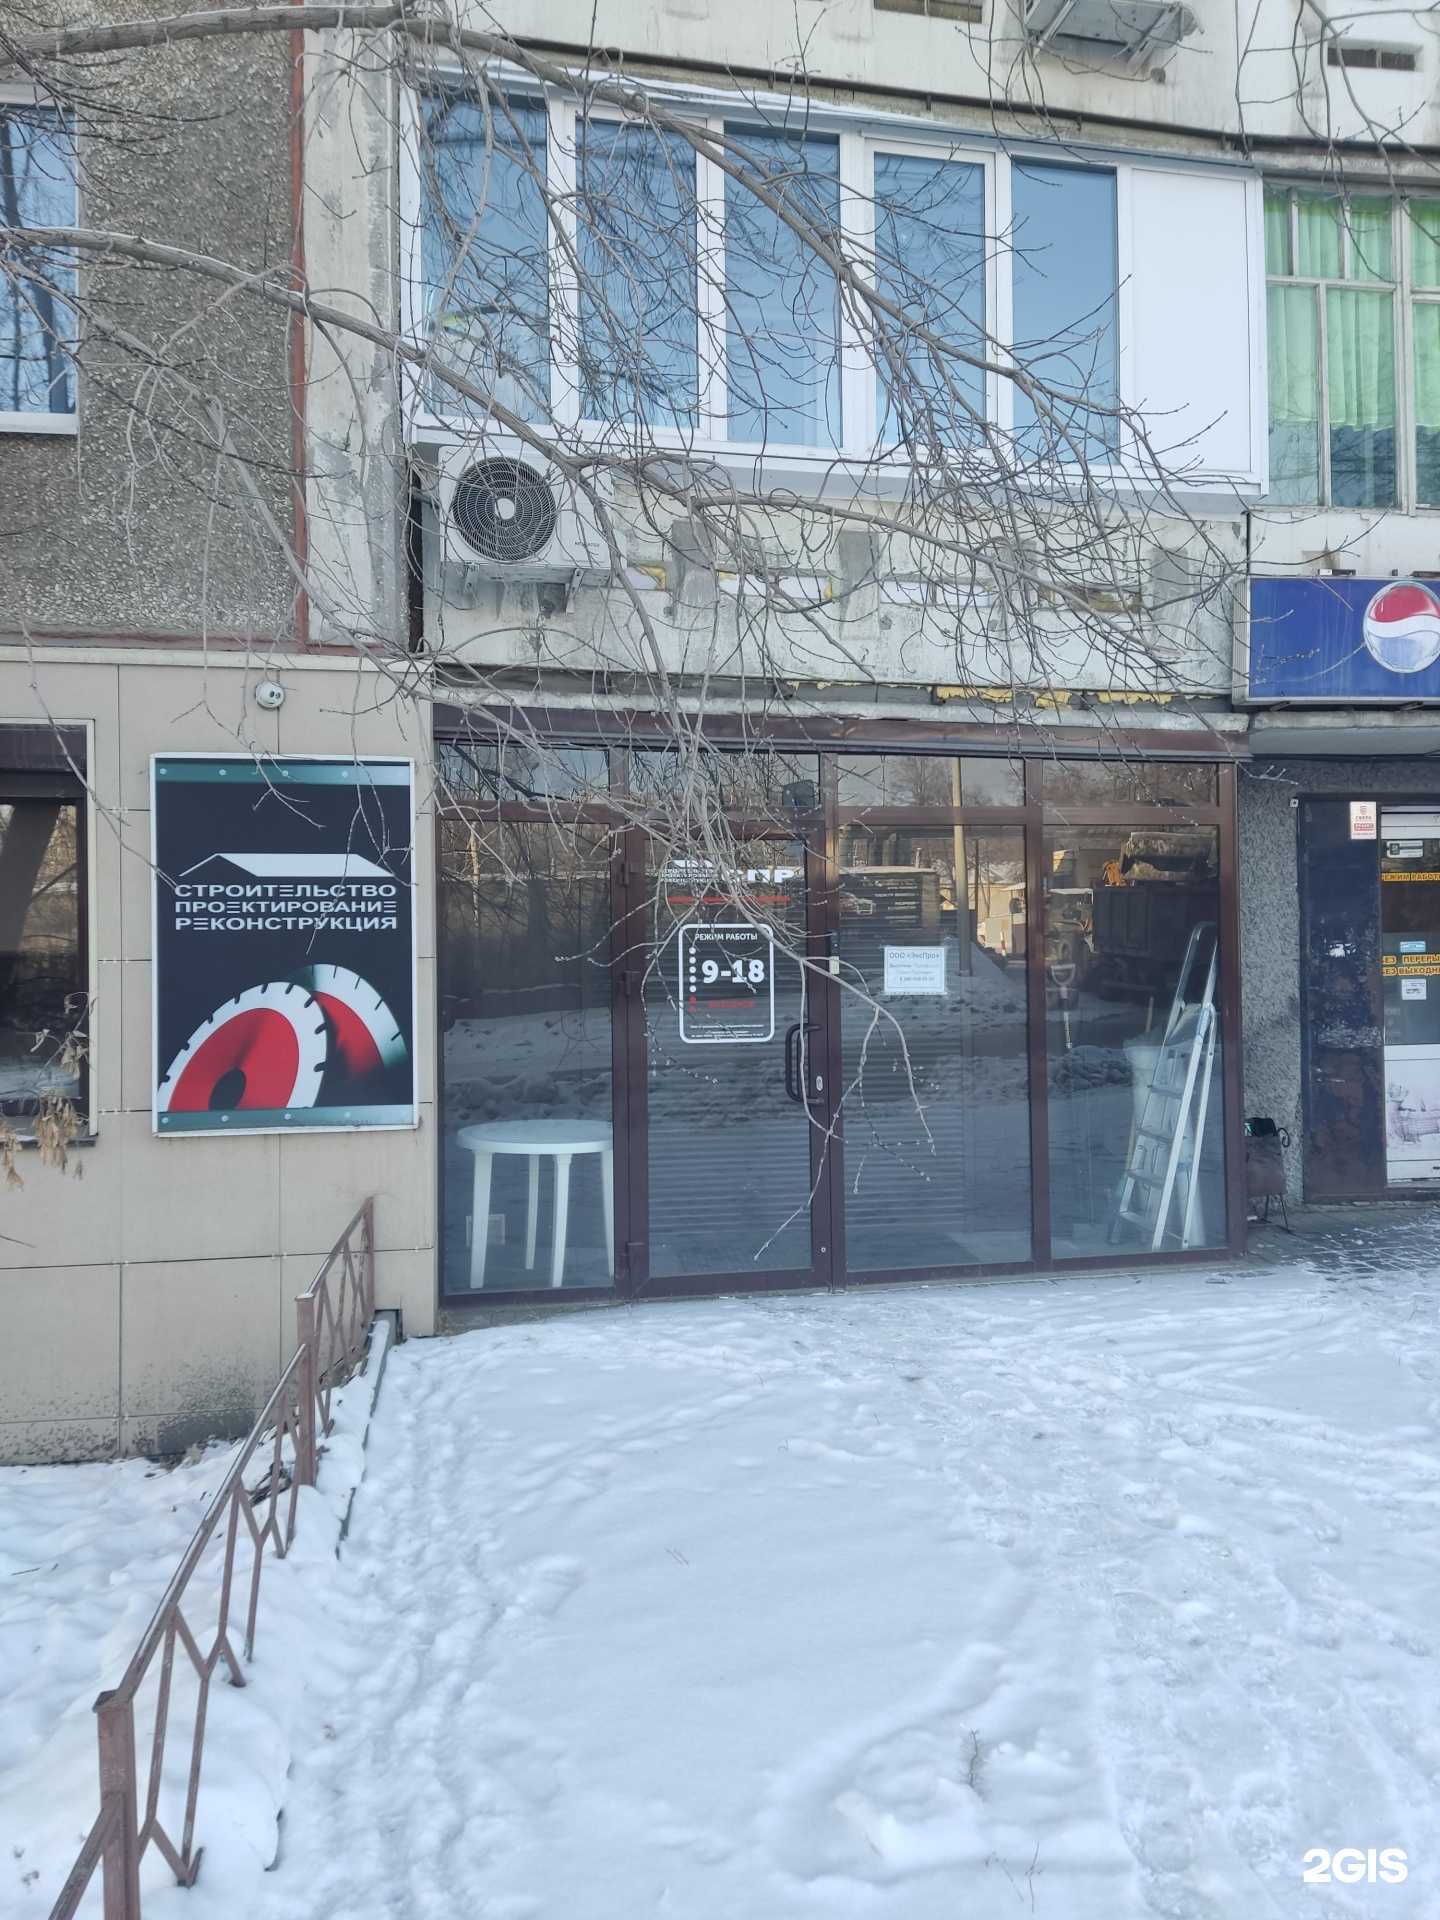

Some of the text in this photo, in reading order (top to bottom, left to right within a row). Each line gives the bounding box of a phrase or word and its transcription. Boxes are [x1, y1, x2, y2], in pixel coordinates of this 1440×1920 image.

[1410, 872, 1440, 882] РАБОТ
[174, 884, 397, 898] СТРОИТЕЛЬСТВО
[175, 900, 397, 914] ПРОЕКТИРОВАНИЕ
[175, 917, 397, 932] РЕКОНСТРУКЦИЯ
[695, 932, 758, 941] РЕЖИМ РАБОТЫ
[1382, 955, 1397, 965] ЕЗ
[701, 959, 765, 984] 9-18
[1382, 966, 1397, 976] ЕЗ
